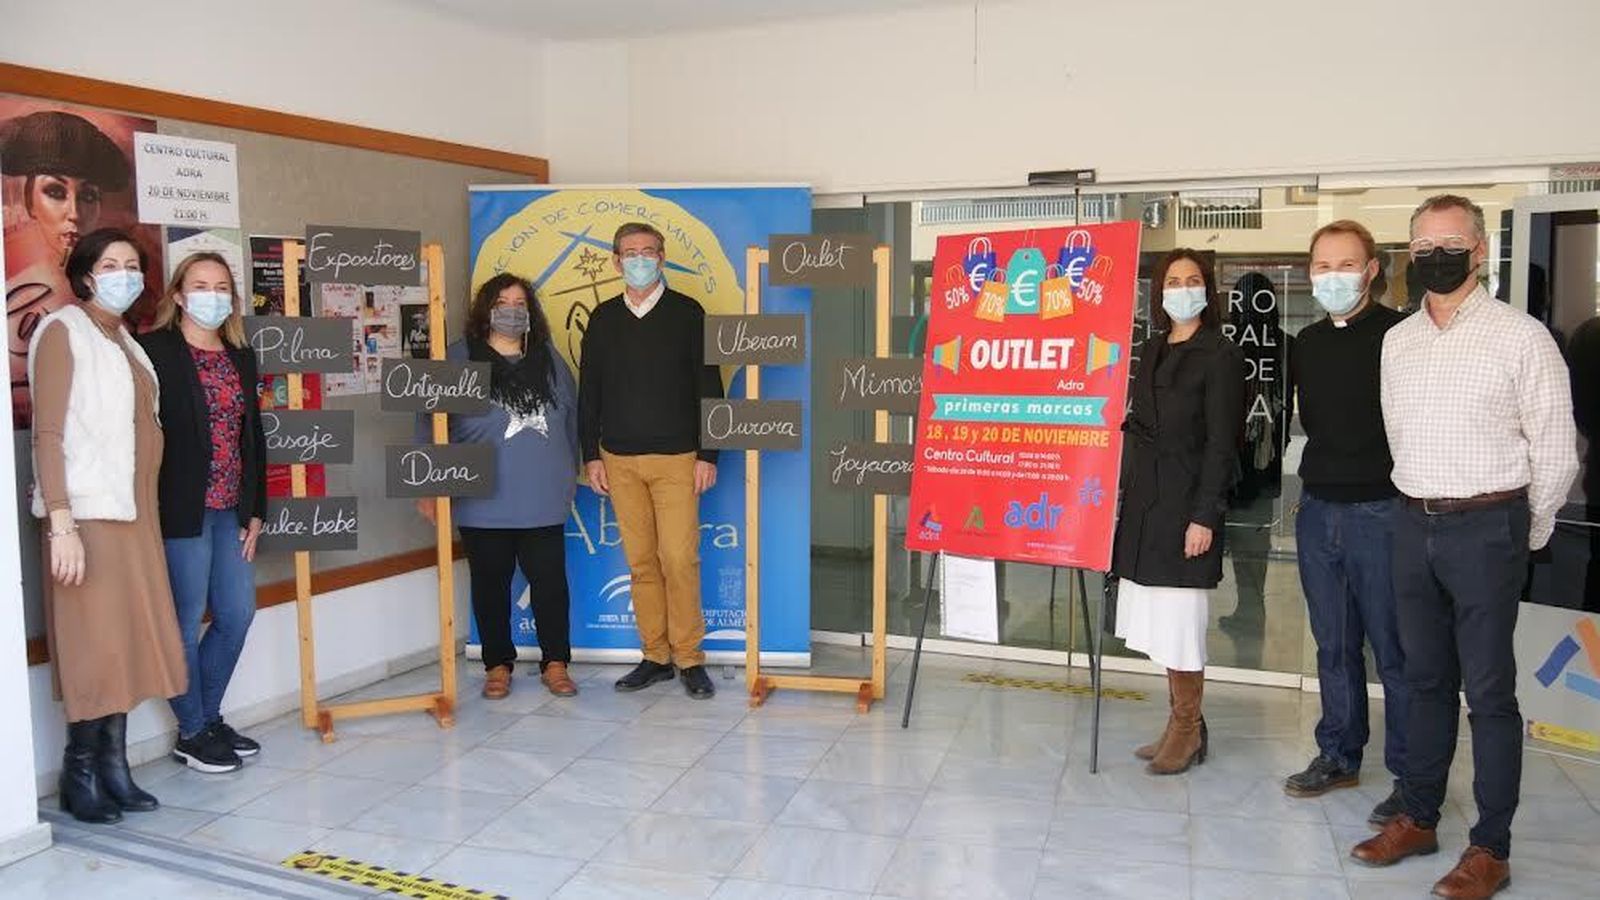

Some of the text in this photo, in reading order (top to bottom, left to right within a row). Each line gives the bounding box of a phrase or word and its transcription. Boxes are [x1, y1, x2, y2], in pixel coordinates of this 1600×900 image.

[144, 143, 230, 162] CENTRO CULTURAL
[176, 167, 203, 178] ADRA
[162, 186, 174, 197] DE
[176, 188, 230, 201] NOVIEMBRE
[543, 206, 569, 226] DE
[308, 232, 417, 280] Expositores
[944, 286, 970, 310] 50%
[1045, 290, 1073, 312] 70%
[1076, 277, 1105, 305] 50%
[979, 292, 1008, 316] 70%
[252, 326, 341, 366] Pilma
[969, 337, 1075, 371] OUTLET
[1056, 378, 1085, 392] Adra
[944, 397, 1093, 416] primeras marcas
[953, 425, 968, 441] 19
[970, 429, 979, 444] y
[981, 426, 998, 441] 20
[1002, 427, 1020, 443] DE
[1024, 428, 1111, 448] NOVIEMBRE
[924, 446, 965, 463] Centro
[966, 449, 1014, 464] Cultural
[401, 451, 480, 486] Dana
[701, 609, 747, 619] DIPUTACI
